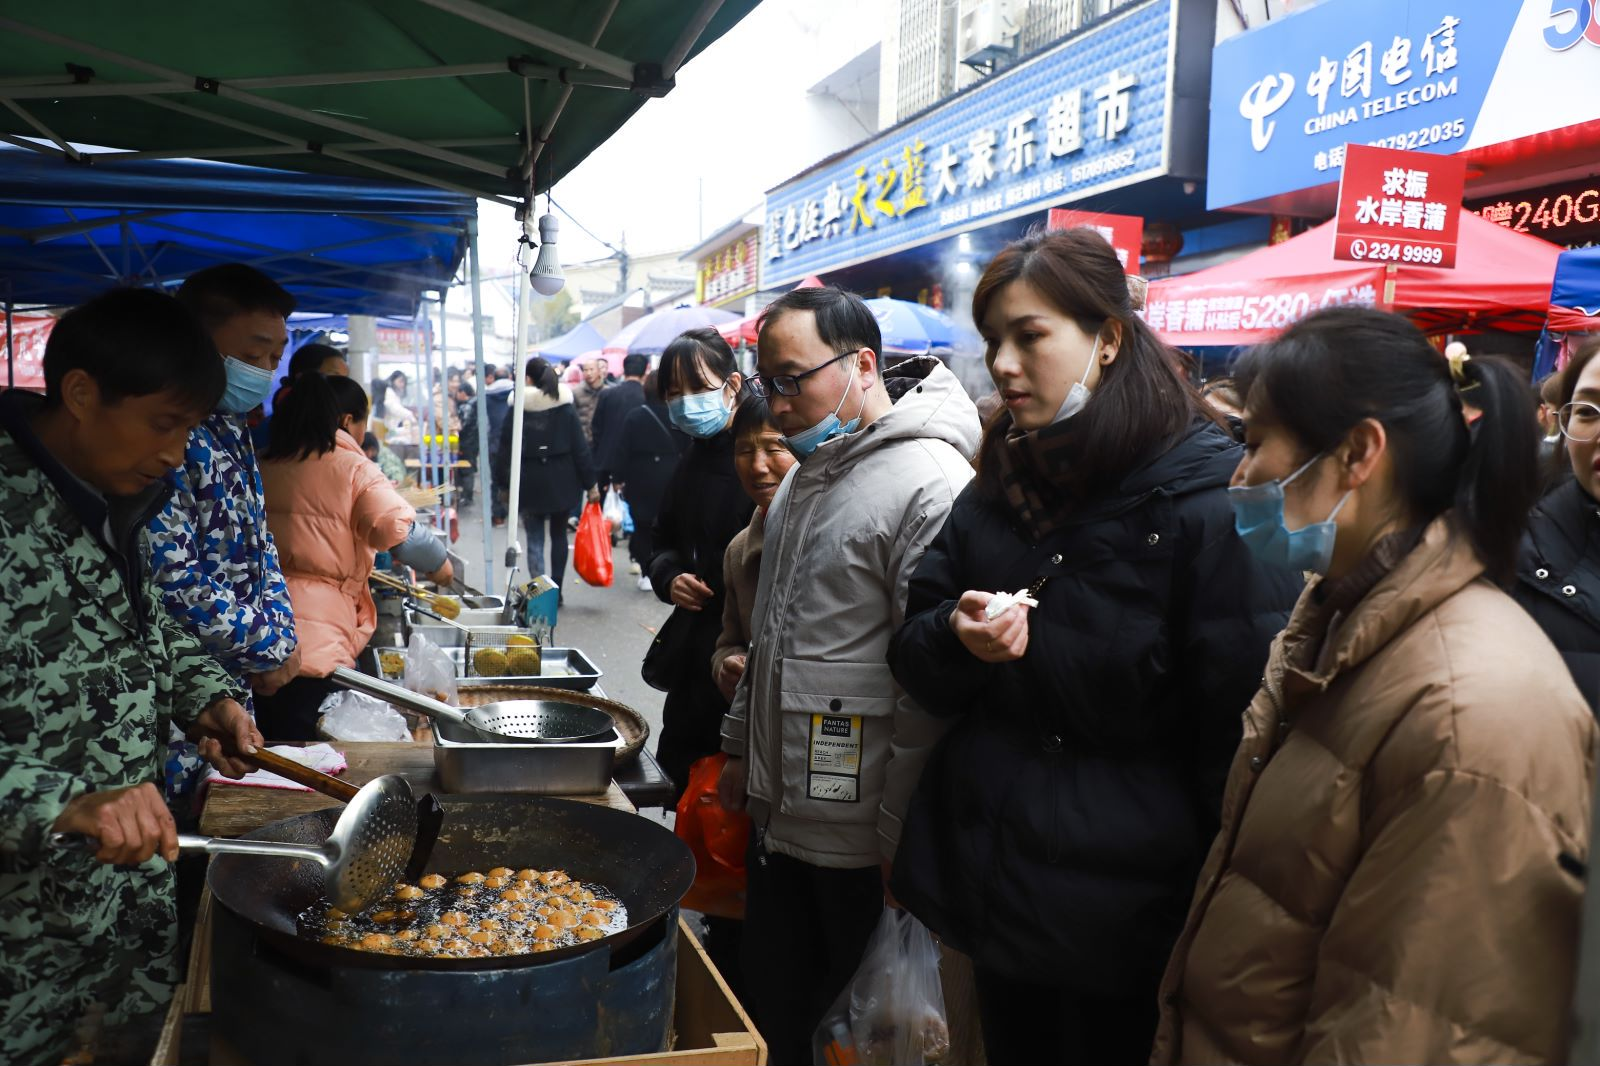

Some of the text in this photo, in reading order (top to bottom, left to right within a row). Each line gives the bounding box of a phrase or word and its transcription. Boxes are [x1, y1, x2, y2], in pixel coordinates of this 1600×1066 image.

[1542, 0, 1600, 52] 5
[1305, 15, 1461, 114] 中国电信
[1304, 76, 1459, 135] CHINA TELECOM
[931, 69, 1139, 200] 大家乐超市
[1382, 167, 1429, 199] 求振
[1355, 196, 1447, 231] 水岸香蒲
[1368, 242, 1443, 264] 234 9999
[1141, 297, 1207, 332] 岸香蒲
[823, 719, 850, 728] FANTAS
[823, 726, 849, 734] NATURE
[813, 740, 859, 749] INDEPENDENT
